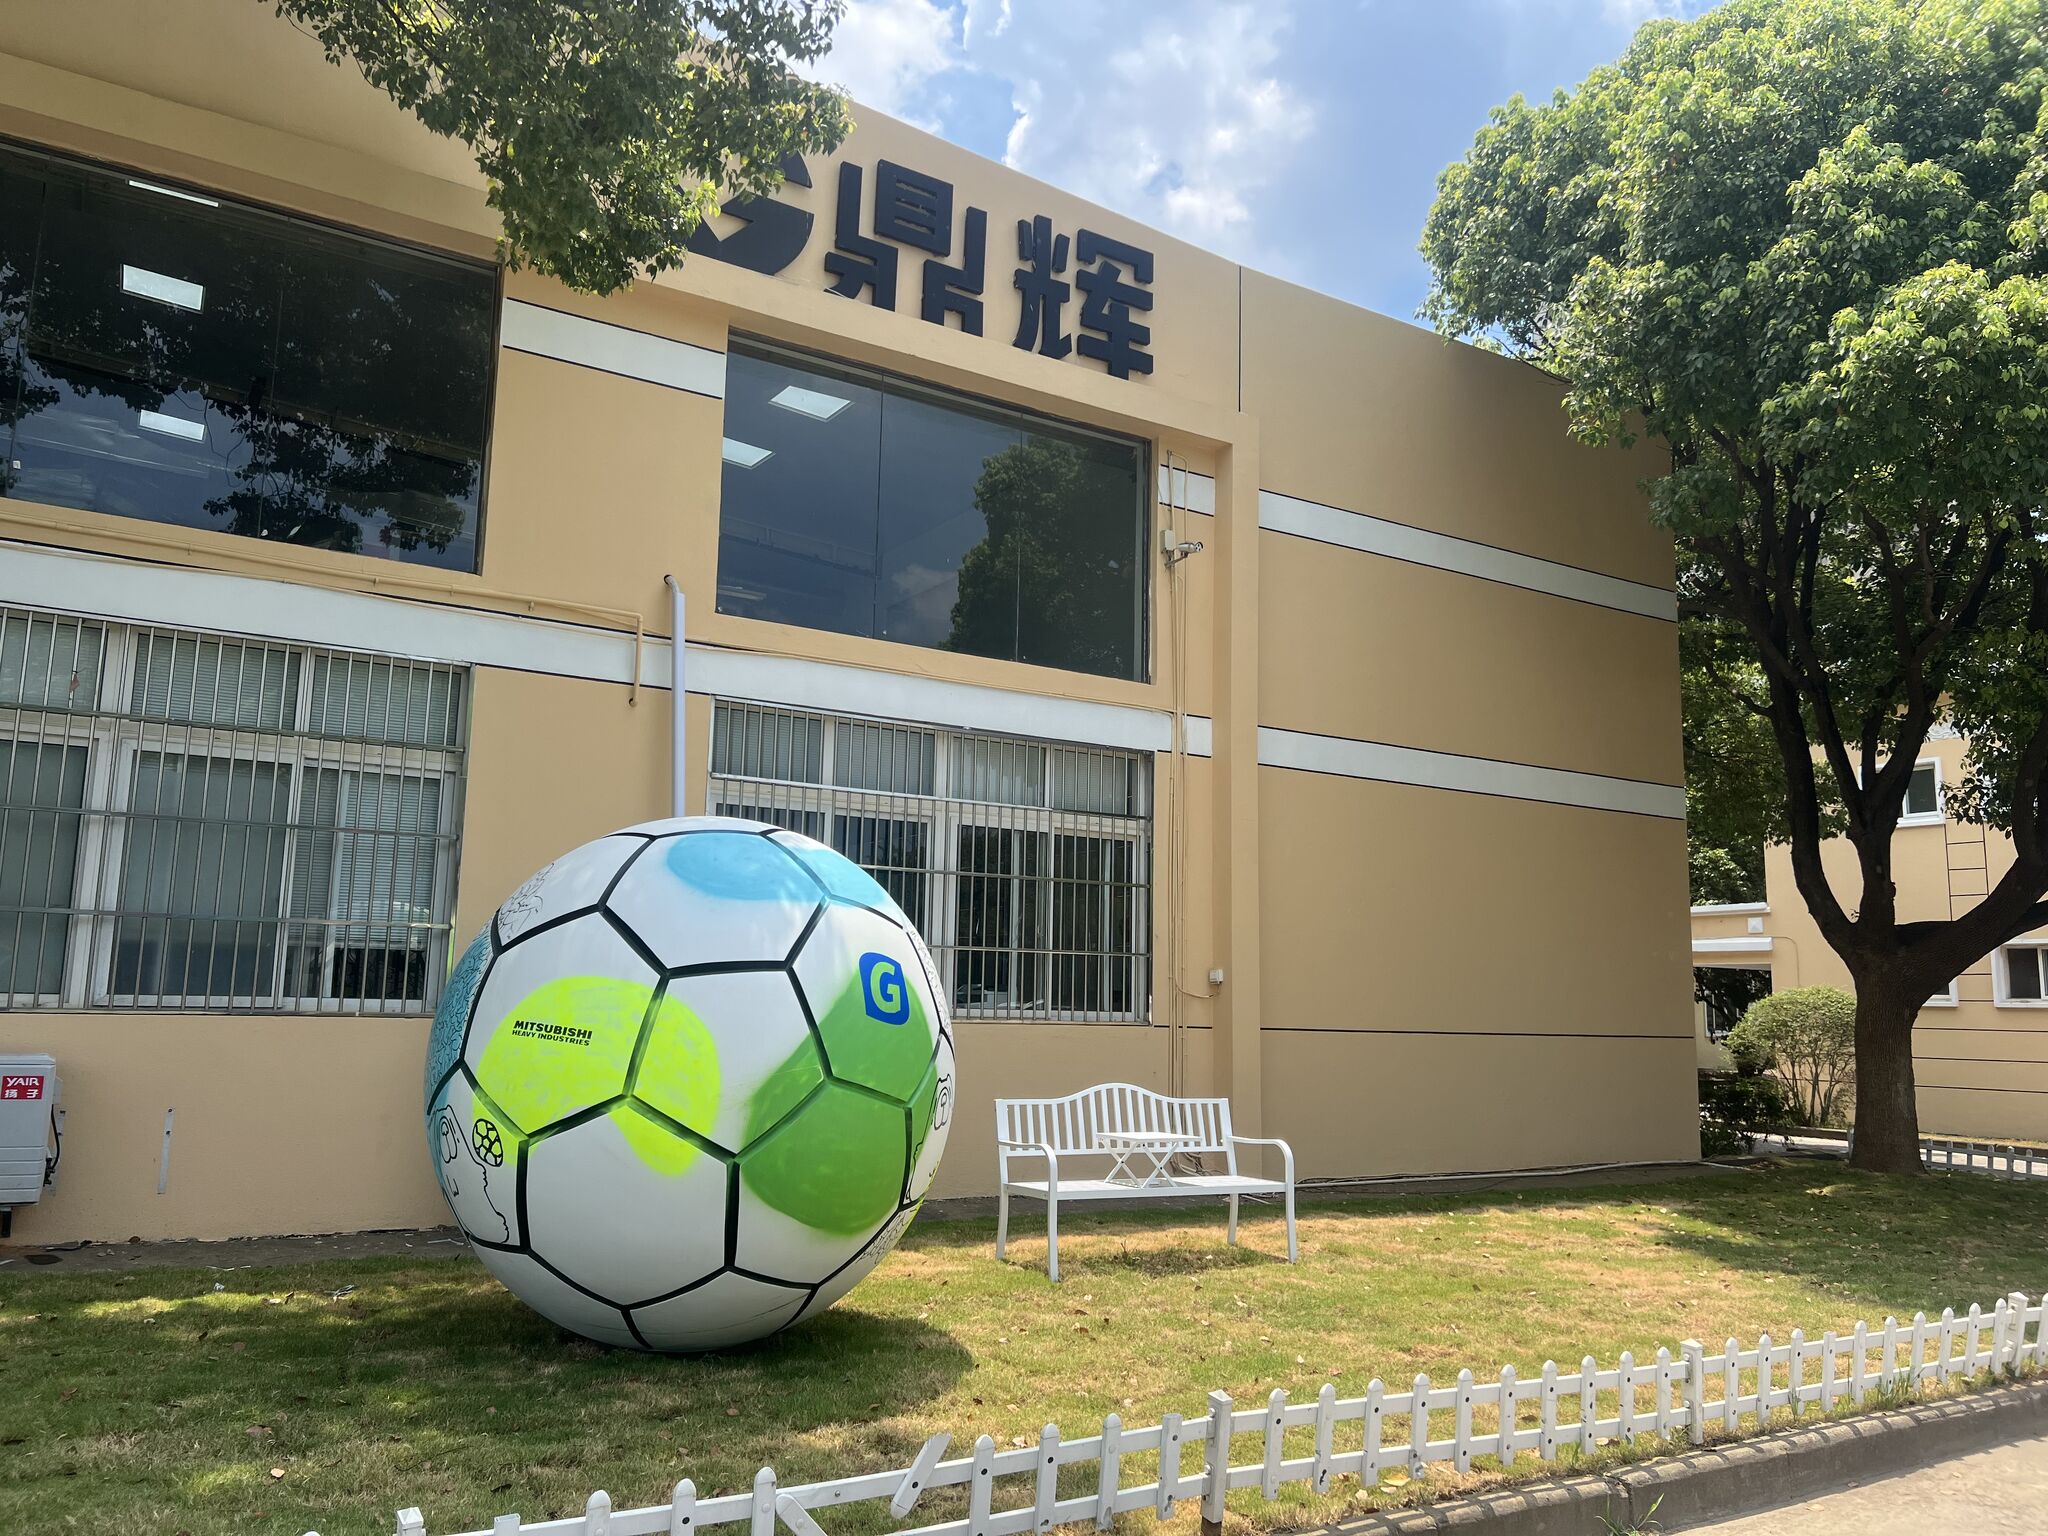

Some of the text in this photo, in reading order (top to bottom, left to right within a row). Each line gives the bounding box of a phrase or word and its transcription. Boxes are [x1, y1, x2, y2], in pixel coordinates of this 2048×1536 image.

[823, 158, 1154, 380] 鼎辉
[870, 961, 901, 1014] G
[512, 1029, 590, 1046] HEAVY INDUSTRIES
[513, 1020, 593, 1039] MITSUBISHI
[6, 1077, 39, 1087] YAIR
